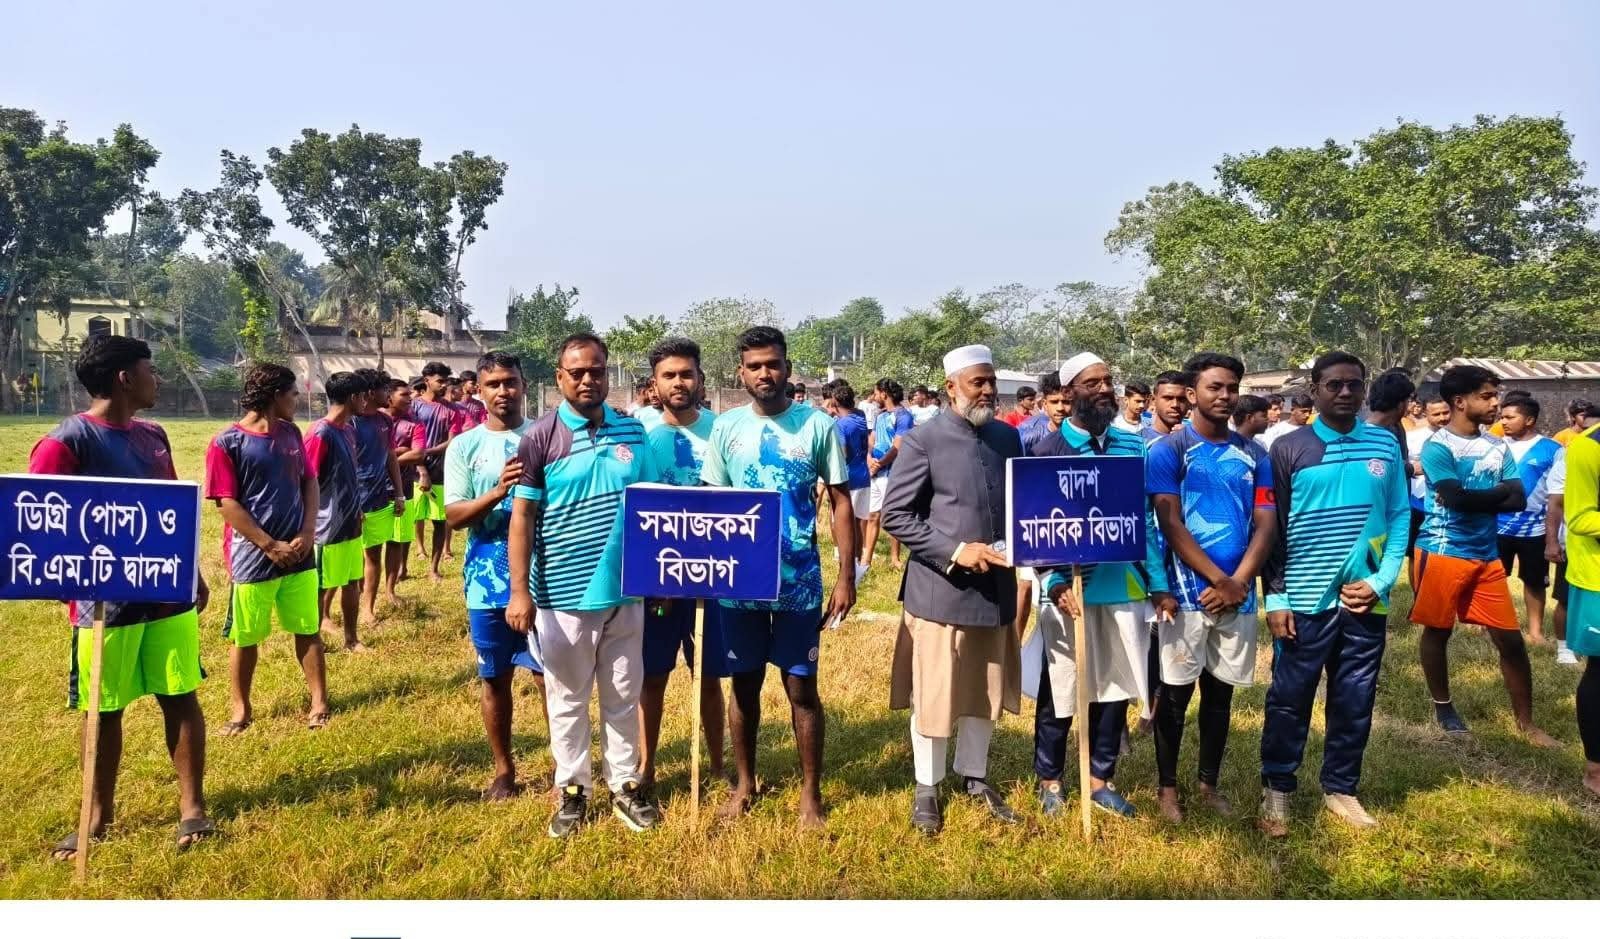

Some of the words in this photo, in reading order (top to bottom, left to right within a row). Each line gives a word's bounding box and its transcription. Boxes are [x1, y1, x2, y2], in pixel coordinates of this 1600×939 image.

[1056, 465, 1101, 501] দ্বাদশ
[14, 490, 72, 537] ডিগ্রি
[79, 498, 148, 546] (পাস)
[158, 508, 177, 536] ও
[636, 503, 762, 543] সমাজকর্ম
[1018, 507, 1084, 549] মানবিক
[1087, 505, 1139, 546] বিভাগ
[8, 542, 117, 587] বি.এম.টি
[121, 552, 182, 588] দ্বাদশ
[655, 547, 740, 588] বিভাগ
